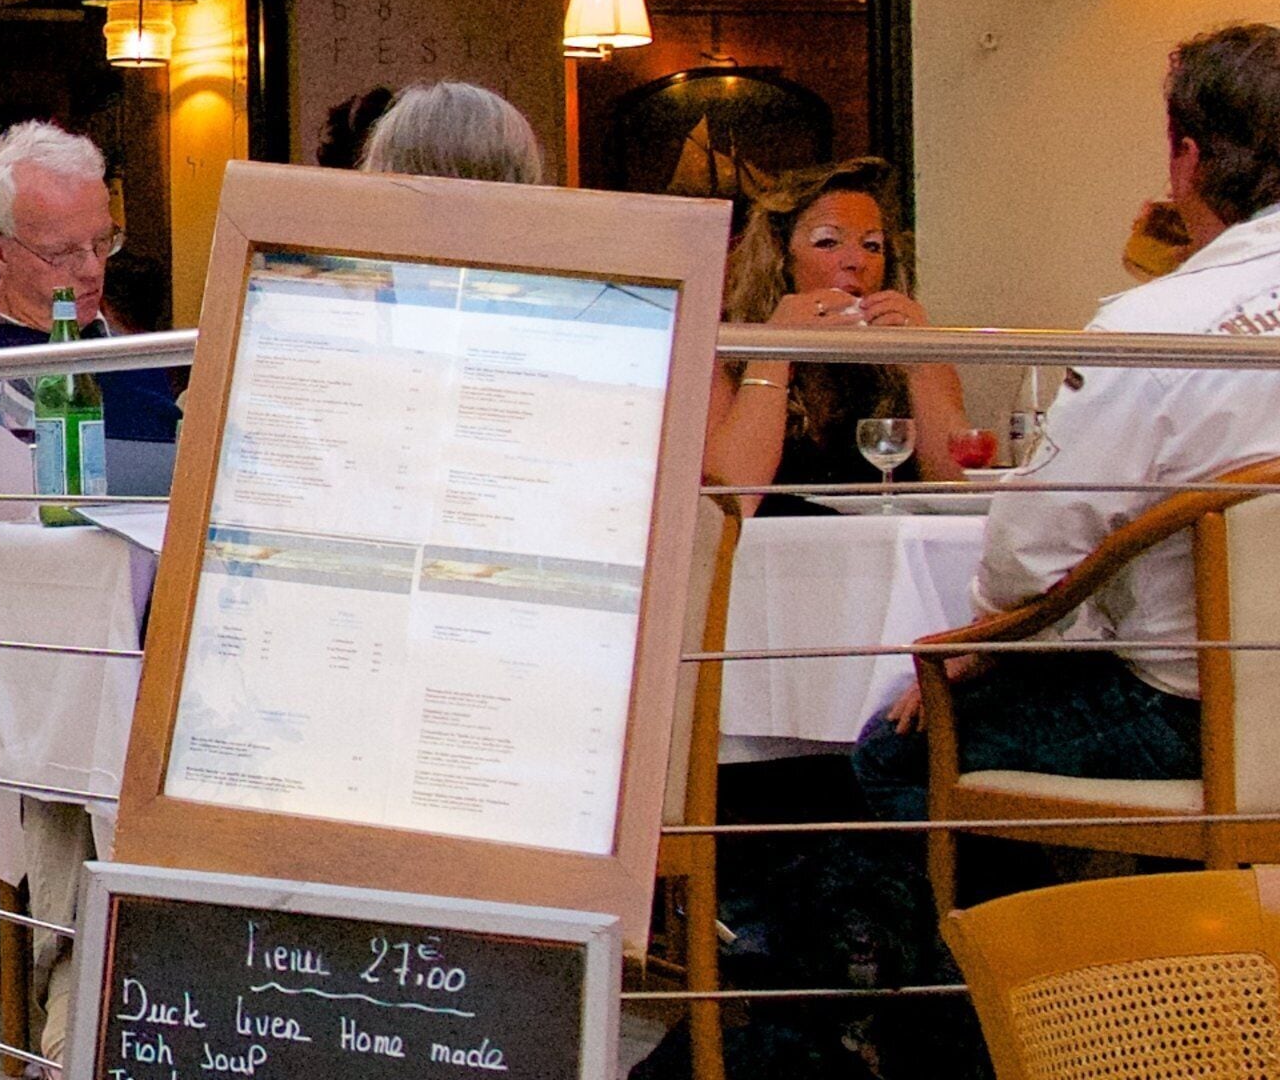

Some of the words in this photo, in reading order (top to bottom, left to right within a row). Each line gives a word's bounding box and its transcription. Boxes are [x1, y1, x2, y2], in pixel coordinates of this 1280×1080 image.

[116, 977, 207, 1029] Duck
[340, 1016, 406, 1059] Home
[430, 1038, 509, 1071] made
